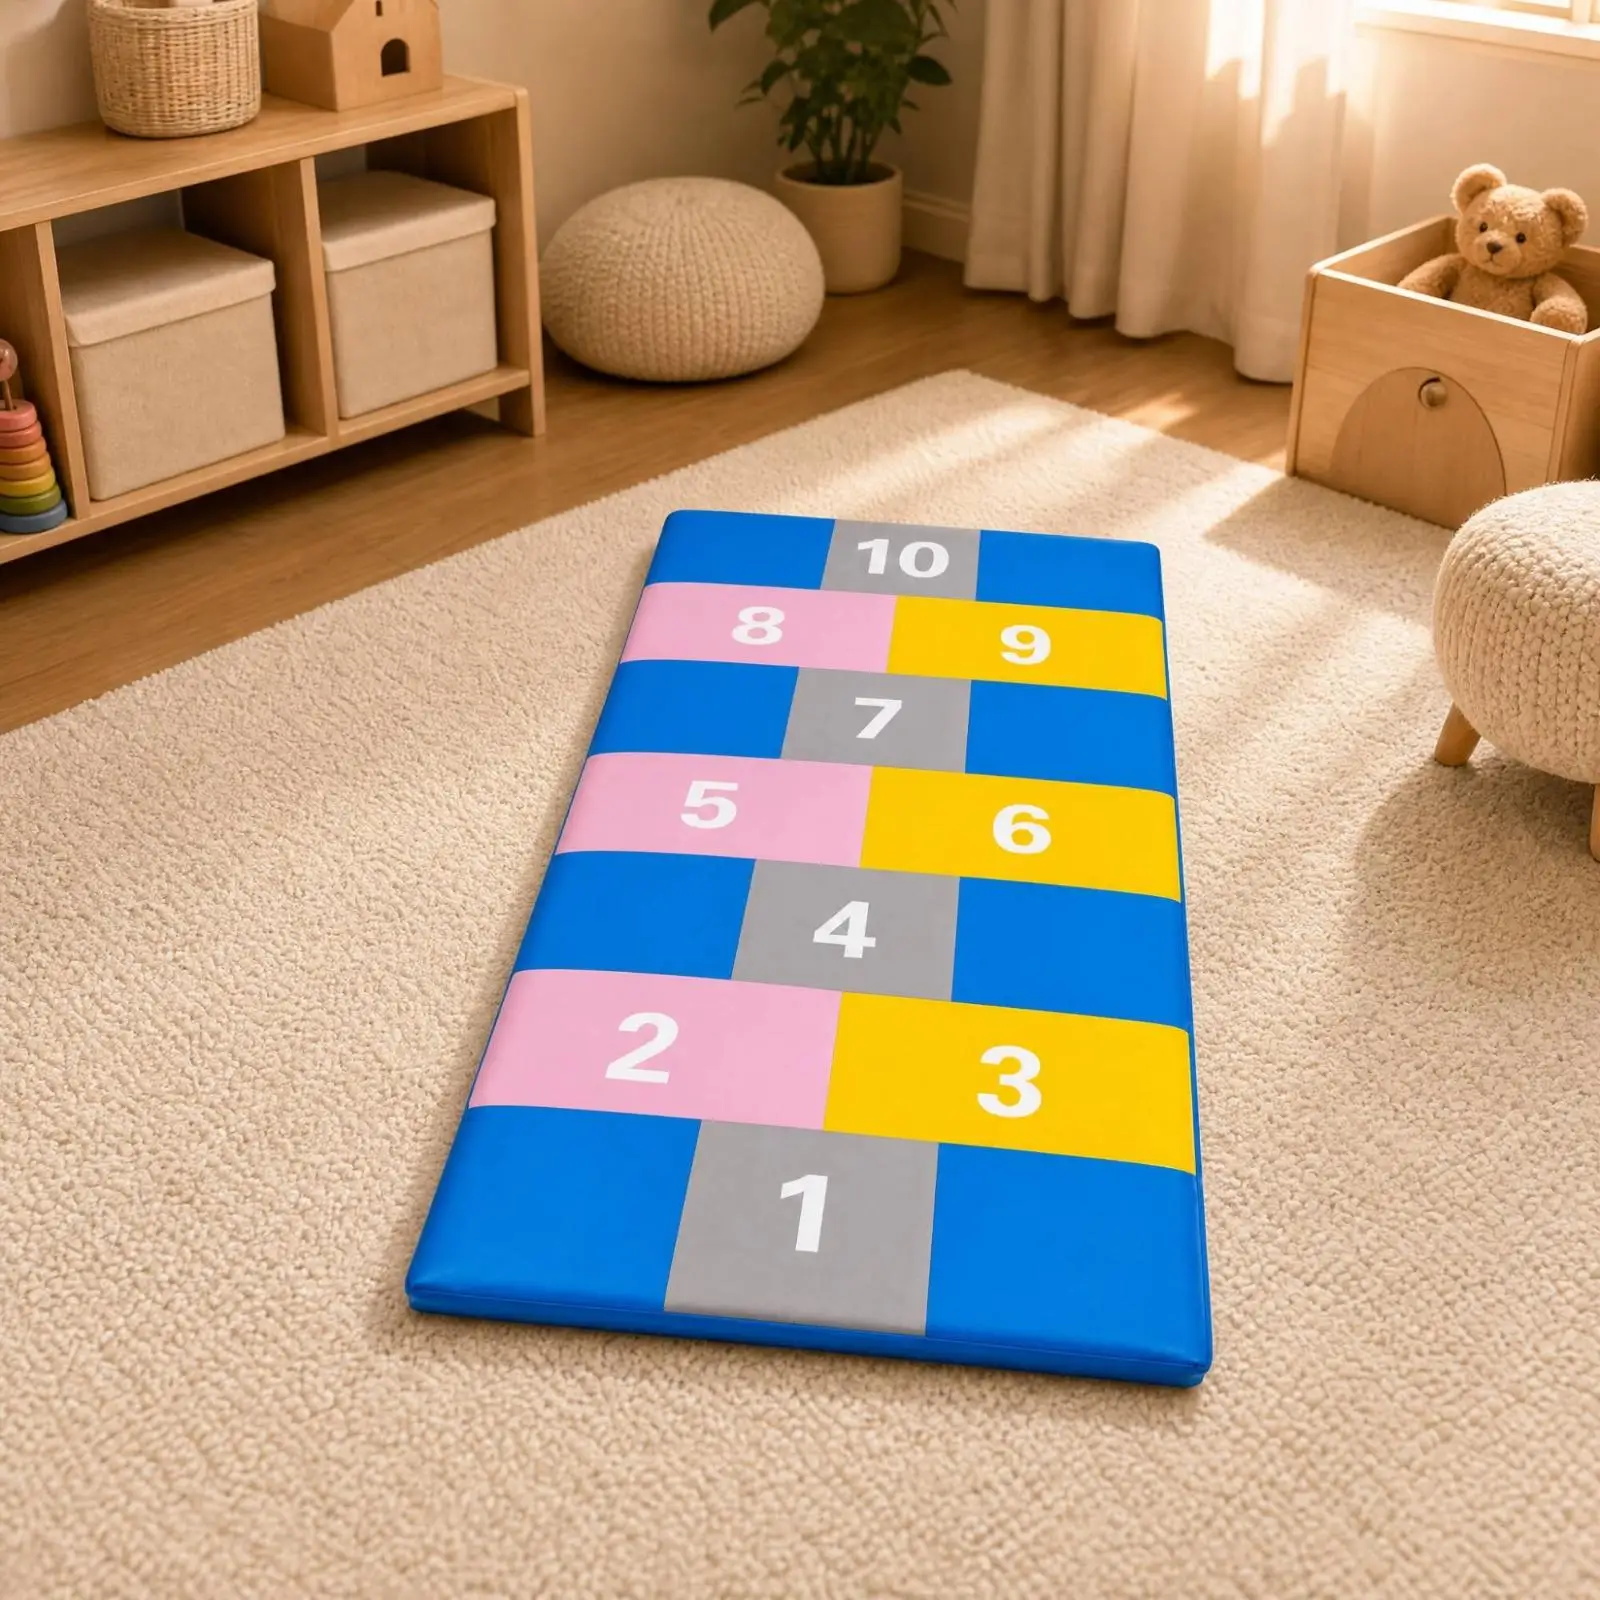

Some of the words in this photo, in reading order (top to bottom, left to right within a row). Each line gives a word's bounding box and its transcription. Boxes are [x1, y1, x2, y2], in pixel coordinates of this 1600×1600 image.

[856, 538, 950, 578] 10
[731, 606, 785, 645] 8
[999, 625, 1051, 665] 9
[853, 697, 902, 739] 7
[680, 780, 738, 829] 5
[992, 804, 1052, 854] 6
[812, 900, 877, 959] 4
[604, 1012, 679, 1084] 2
[977, 1046, 1042, 1118] 3
[779, 1174, 828, 1253] 1
